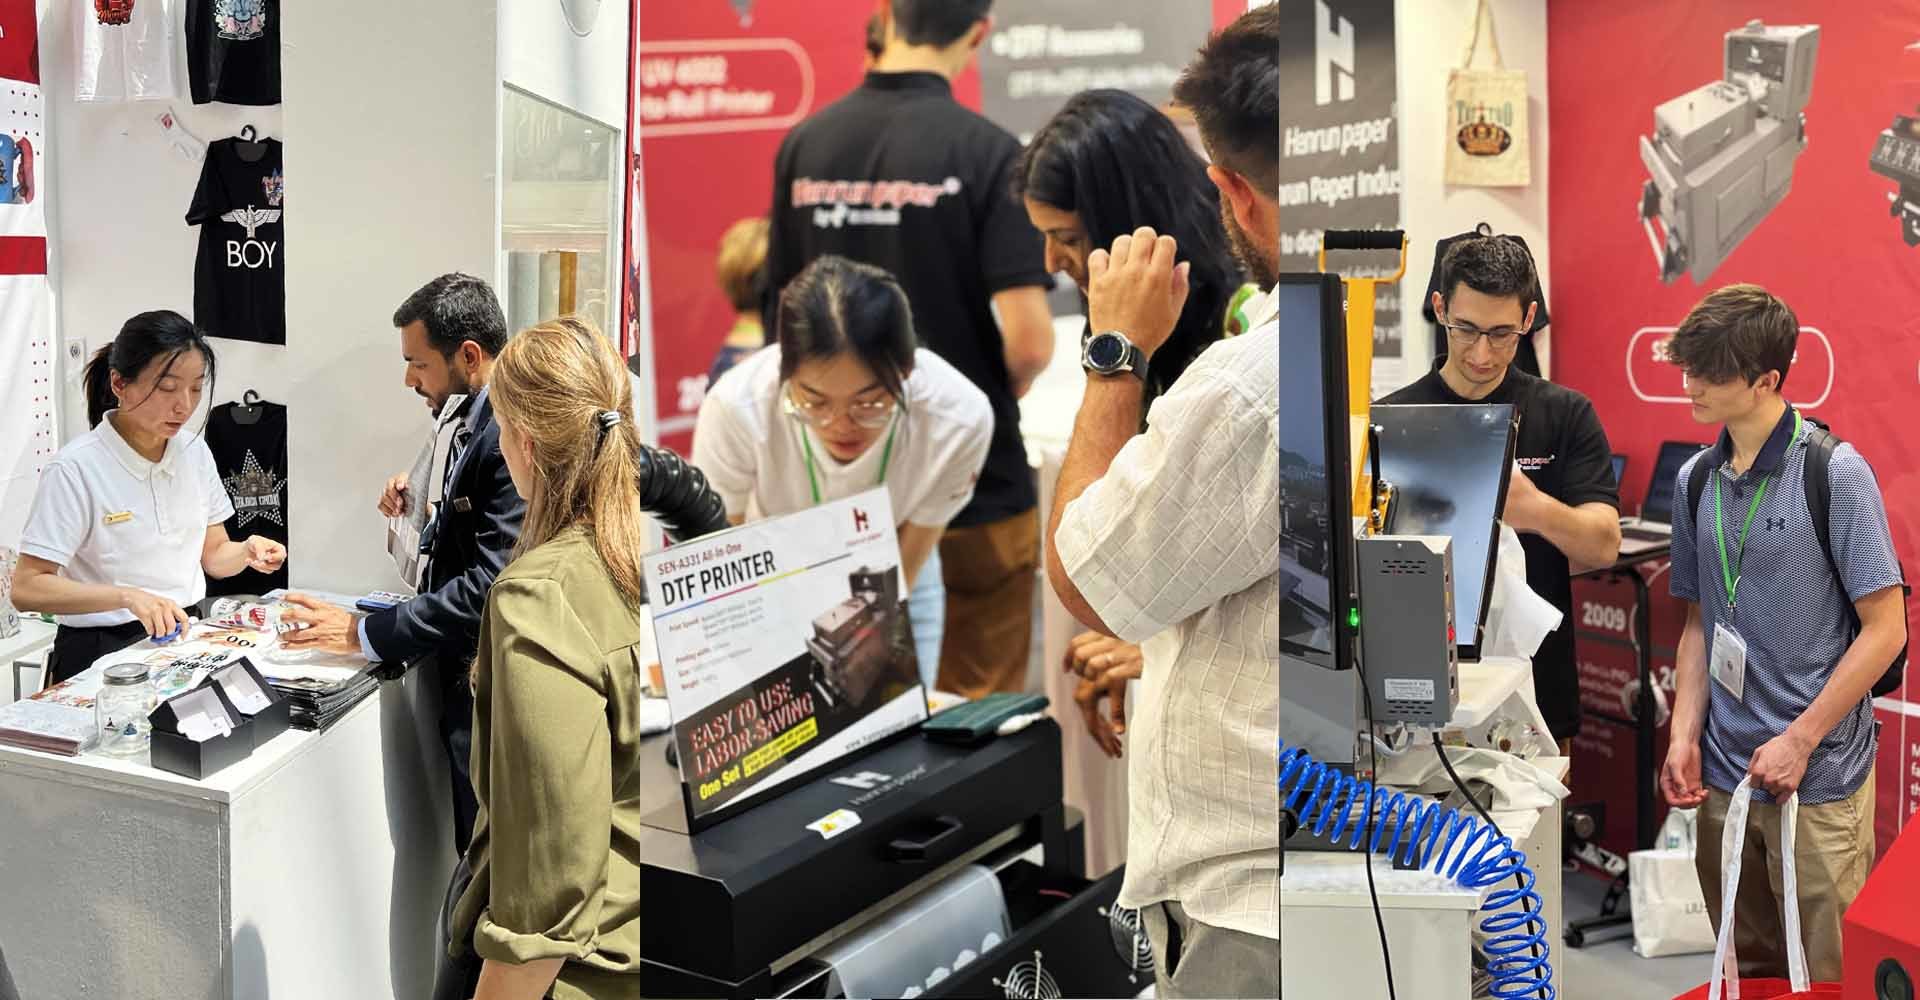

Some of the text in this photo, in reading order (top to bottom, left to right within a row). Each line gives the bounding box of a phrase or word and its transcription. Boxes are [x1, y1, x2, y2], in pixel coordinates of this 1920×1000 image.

[1310, 174, 1355, 208] Paper
[226, 239, 277, 268] BOY
[656, 551, 701, 577] SEN-A331
[661, 549, 777, 607] DTF PRINTER
[1583, 602, 1627, 632] 2009
[689, 708, 734, 753] EASY
[735, 697, 758, 727] TO
[759, 676, 795, 713] USE
[699, 763, 741, 801] One Set
